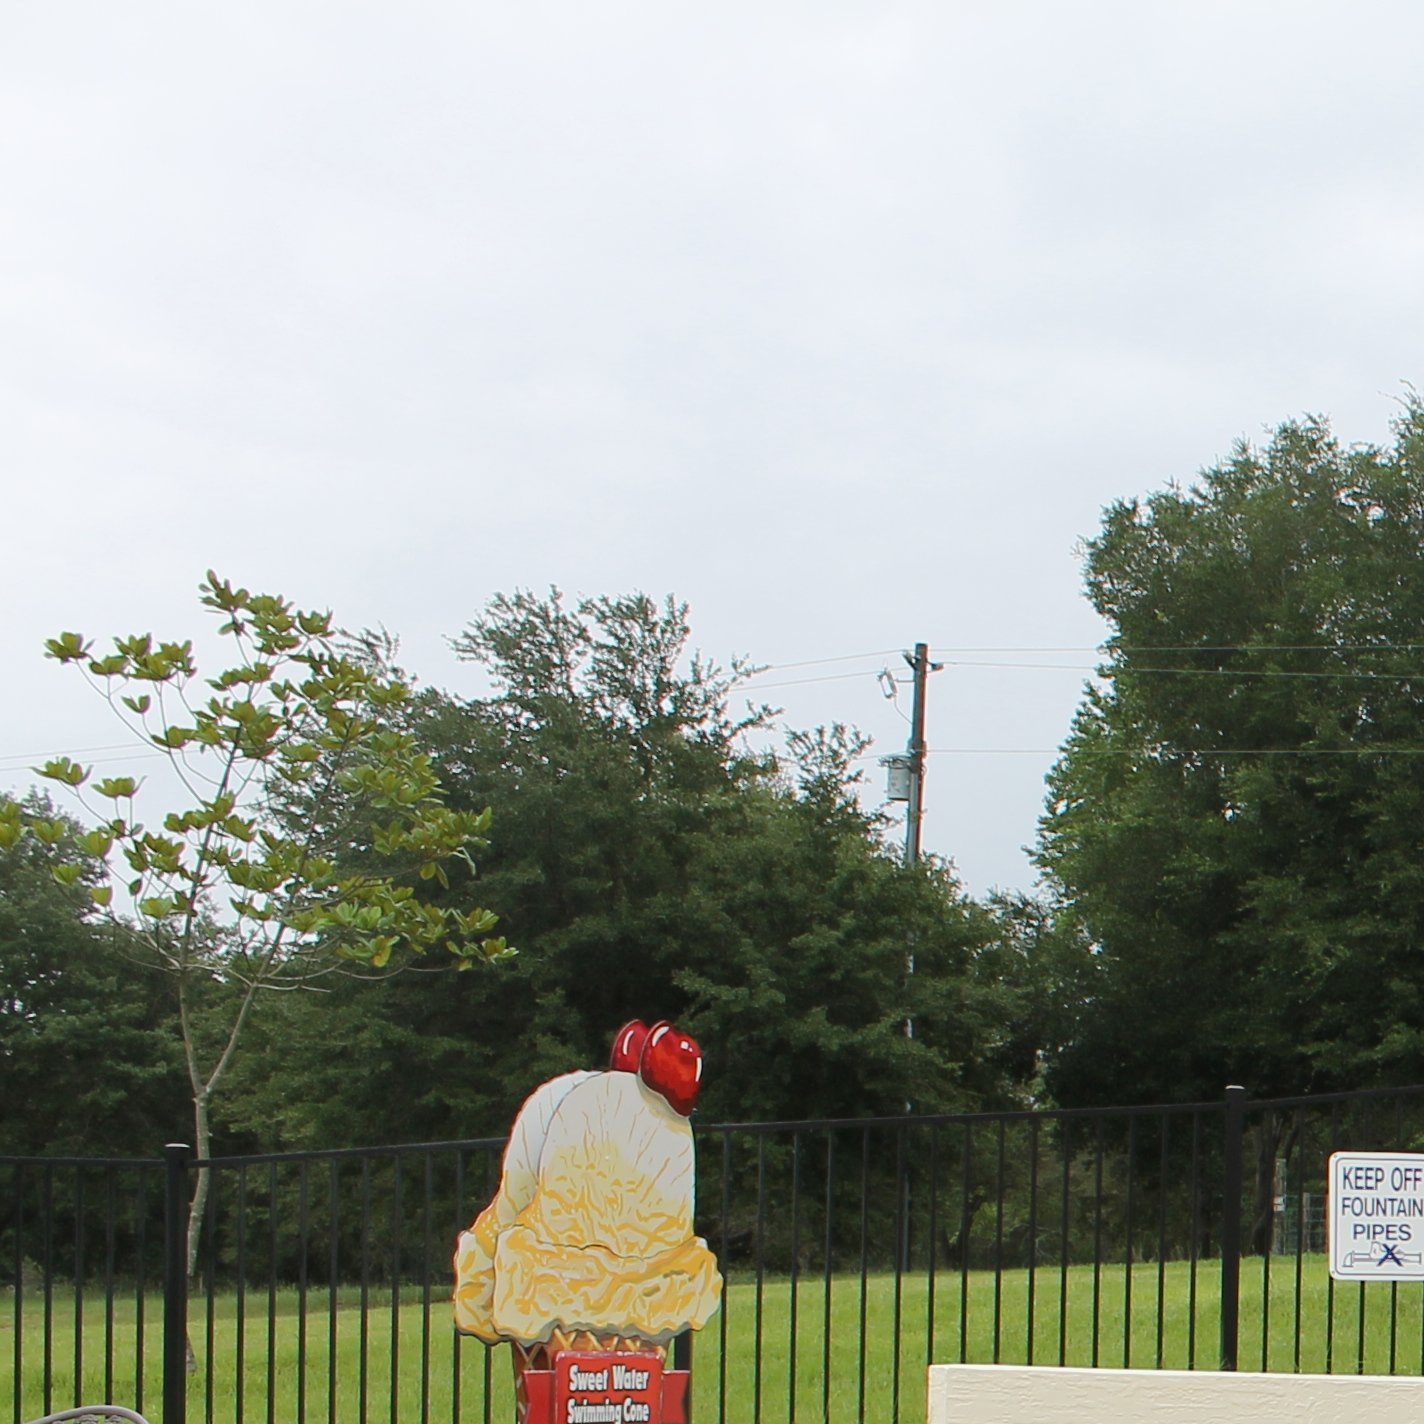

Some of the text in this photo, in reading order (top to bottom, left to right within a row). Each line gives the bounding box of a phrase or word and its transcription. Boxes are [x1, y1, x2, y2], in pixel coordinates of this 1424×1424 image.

[1342, 1166, 1423, 1191] KEEP OFF
[1341, 1197, 1424, 1217] FOUNTAIN
[1353, 1223, 1412, 1241] PIPES
[569, 1364, 649, 1391] Sweet Water
[623, 1397, 650, 1422] Cone
